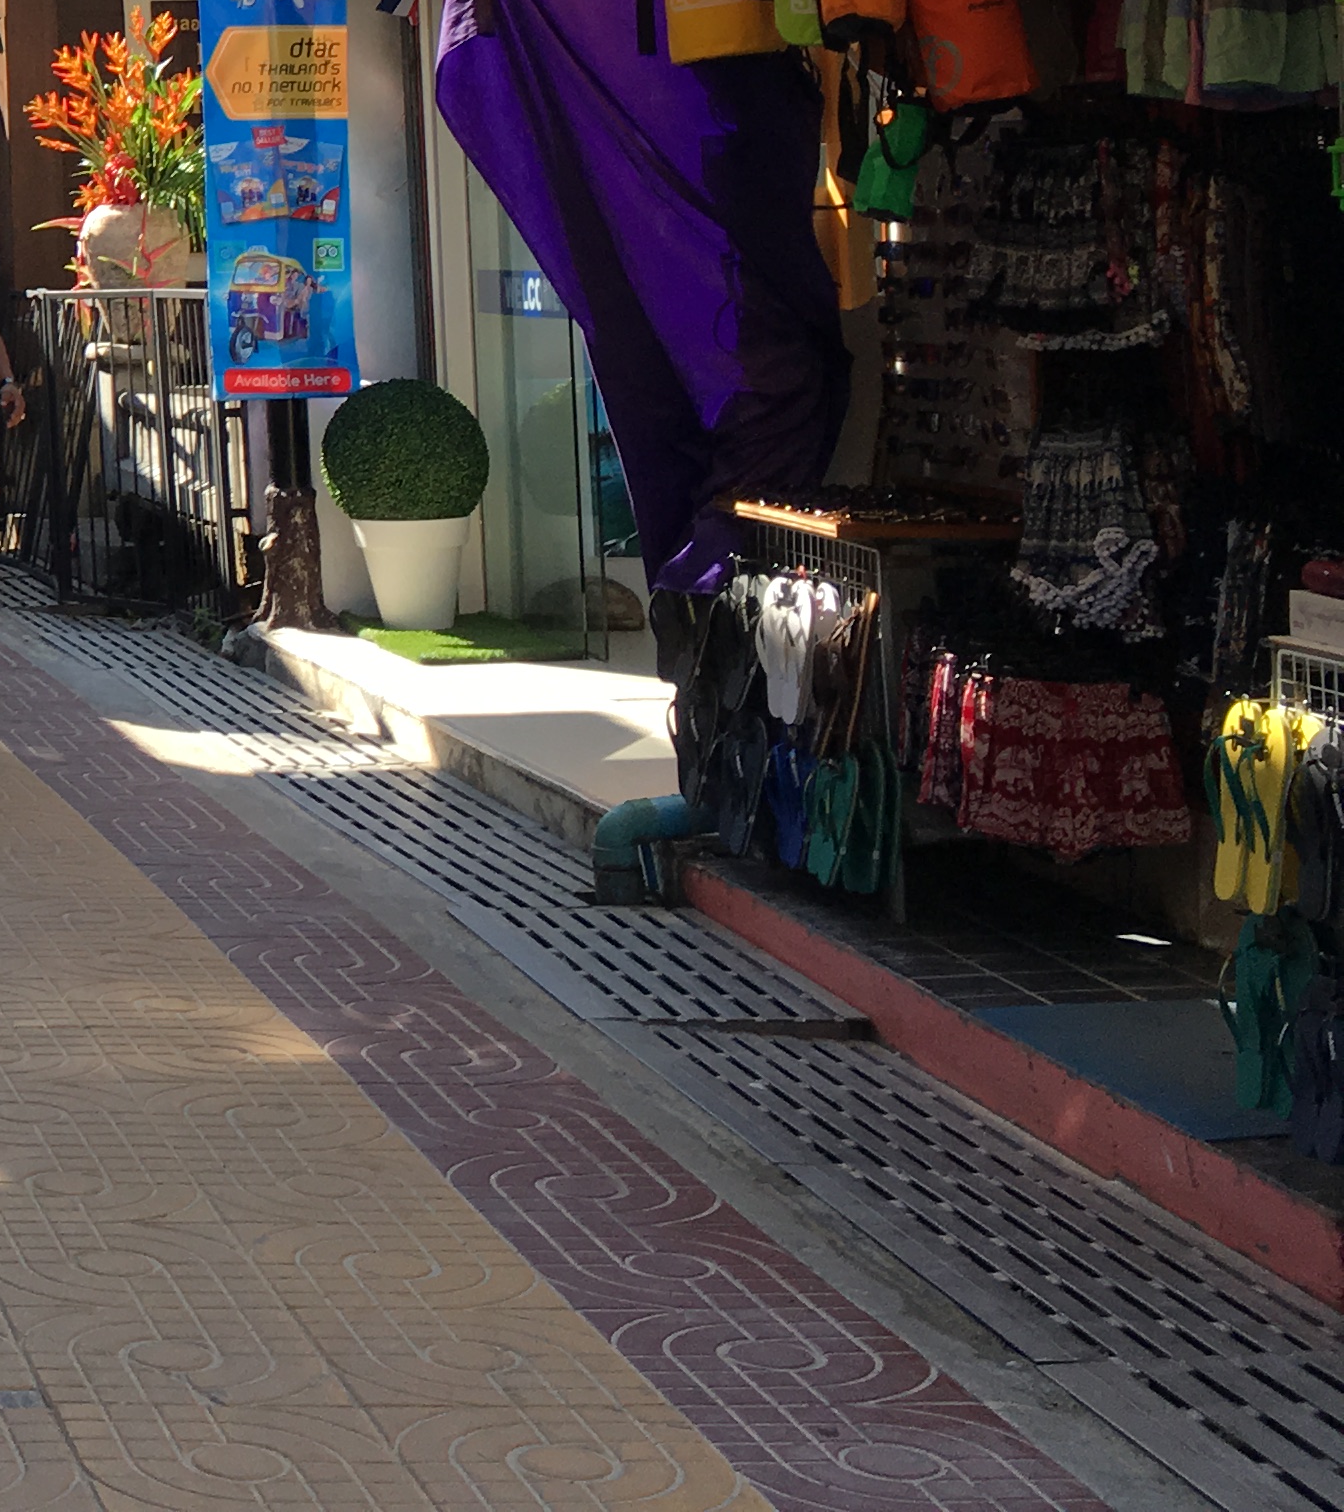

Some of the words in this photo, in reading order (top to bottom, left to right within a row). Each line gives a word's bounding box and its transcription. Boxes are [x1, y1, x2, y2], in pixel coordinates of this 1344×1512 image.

[290, 37, 341, 58] dtac
[234, 374, 300, 388] Available
[304, 374, 341, 387] Here
